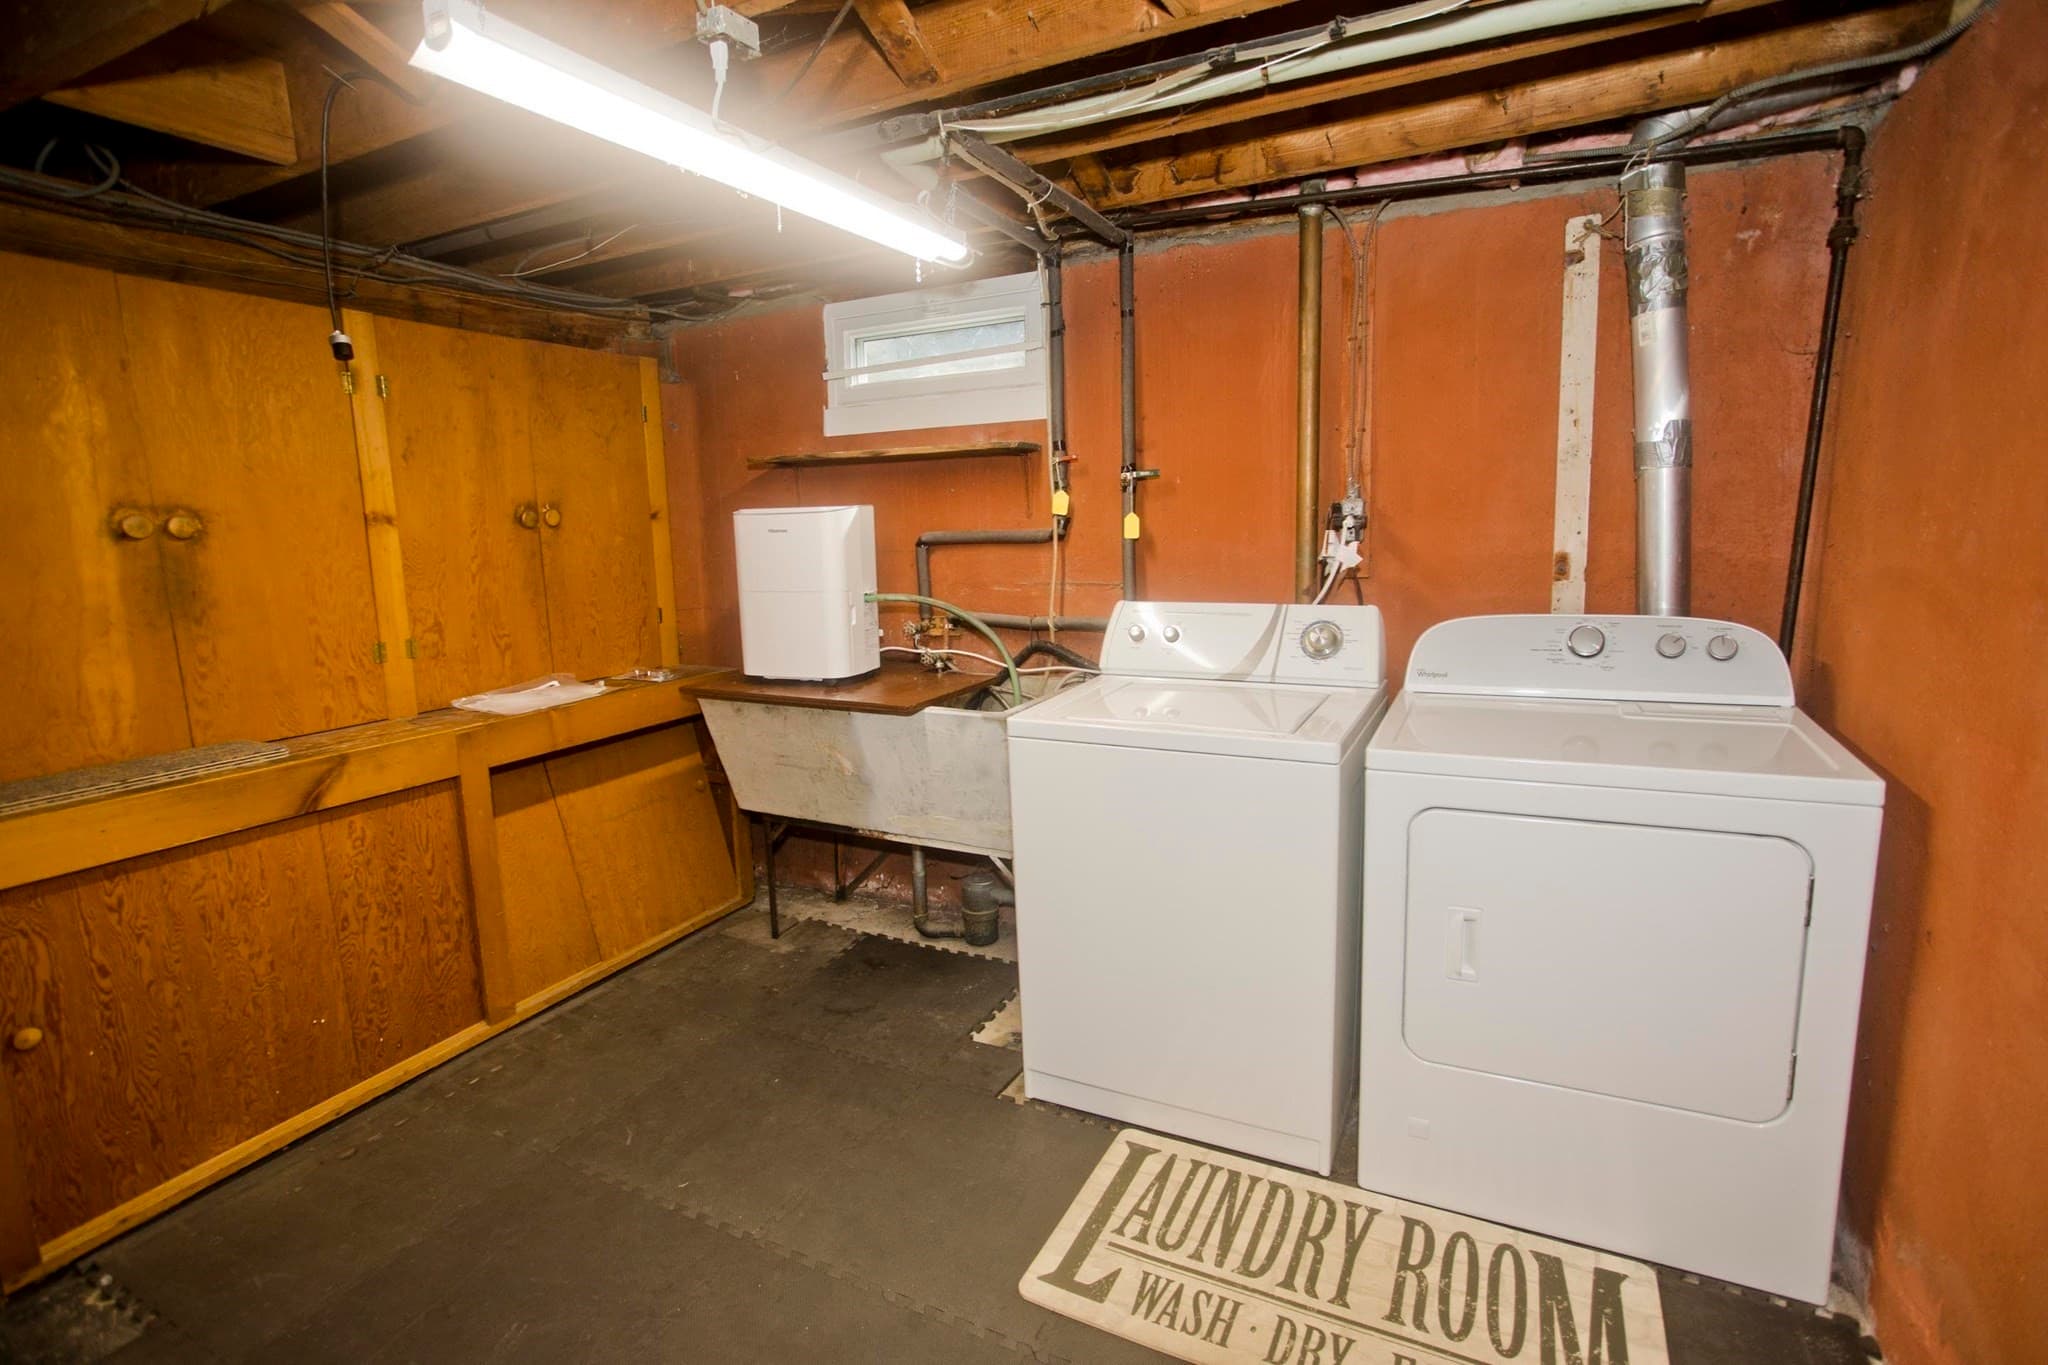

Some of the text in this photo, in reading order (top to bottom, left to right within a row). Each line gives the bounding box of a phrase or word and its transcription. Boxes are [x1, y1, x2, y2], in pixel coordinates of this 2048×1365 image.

[1037, 1140, 1630, 1365] LAUNDRY ROOM
[1130, 1269, 1356, 1365] WASH DRY
